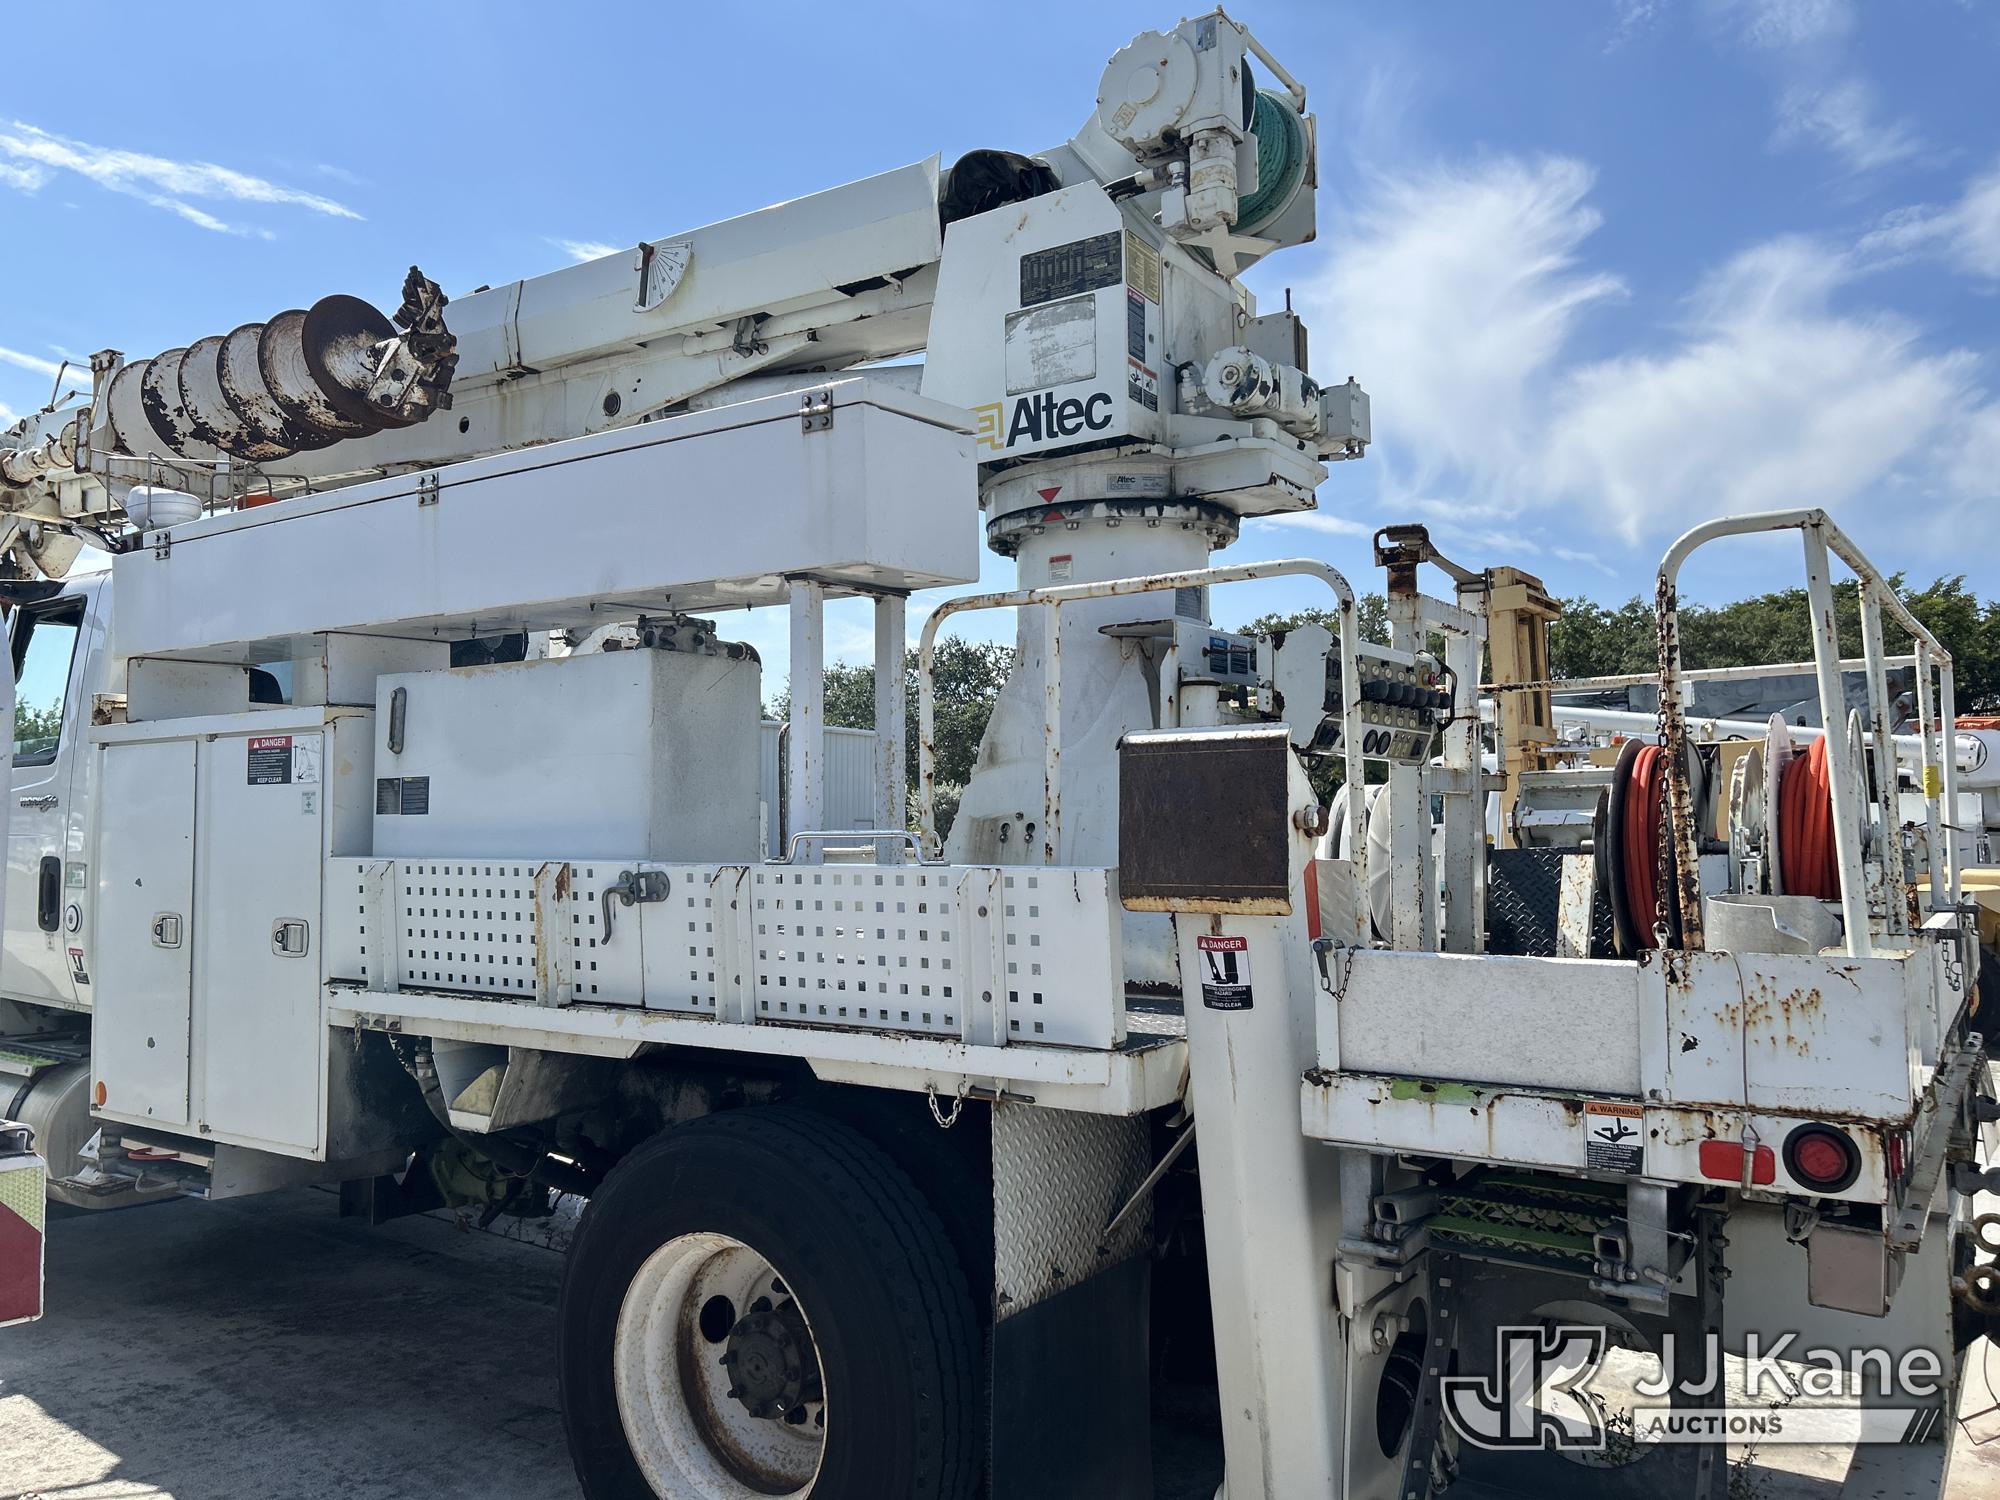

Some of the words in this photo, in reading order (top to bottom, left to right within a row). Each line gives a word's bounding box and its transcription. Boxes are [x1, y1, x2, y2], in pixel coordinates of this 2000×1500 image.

[1006, 391, 1113, 448] Altec
[261, 738, 286, 747] DANGER
[1209, 940, 1242, 949] DANGER
[1599, 1106, 1640, 1116] WARNING
